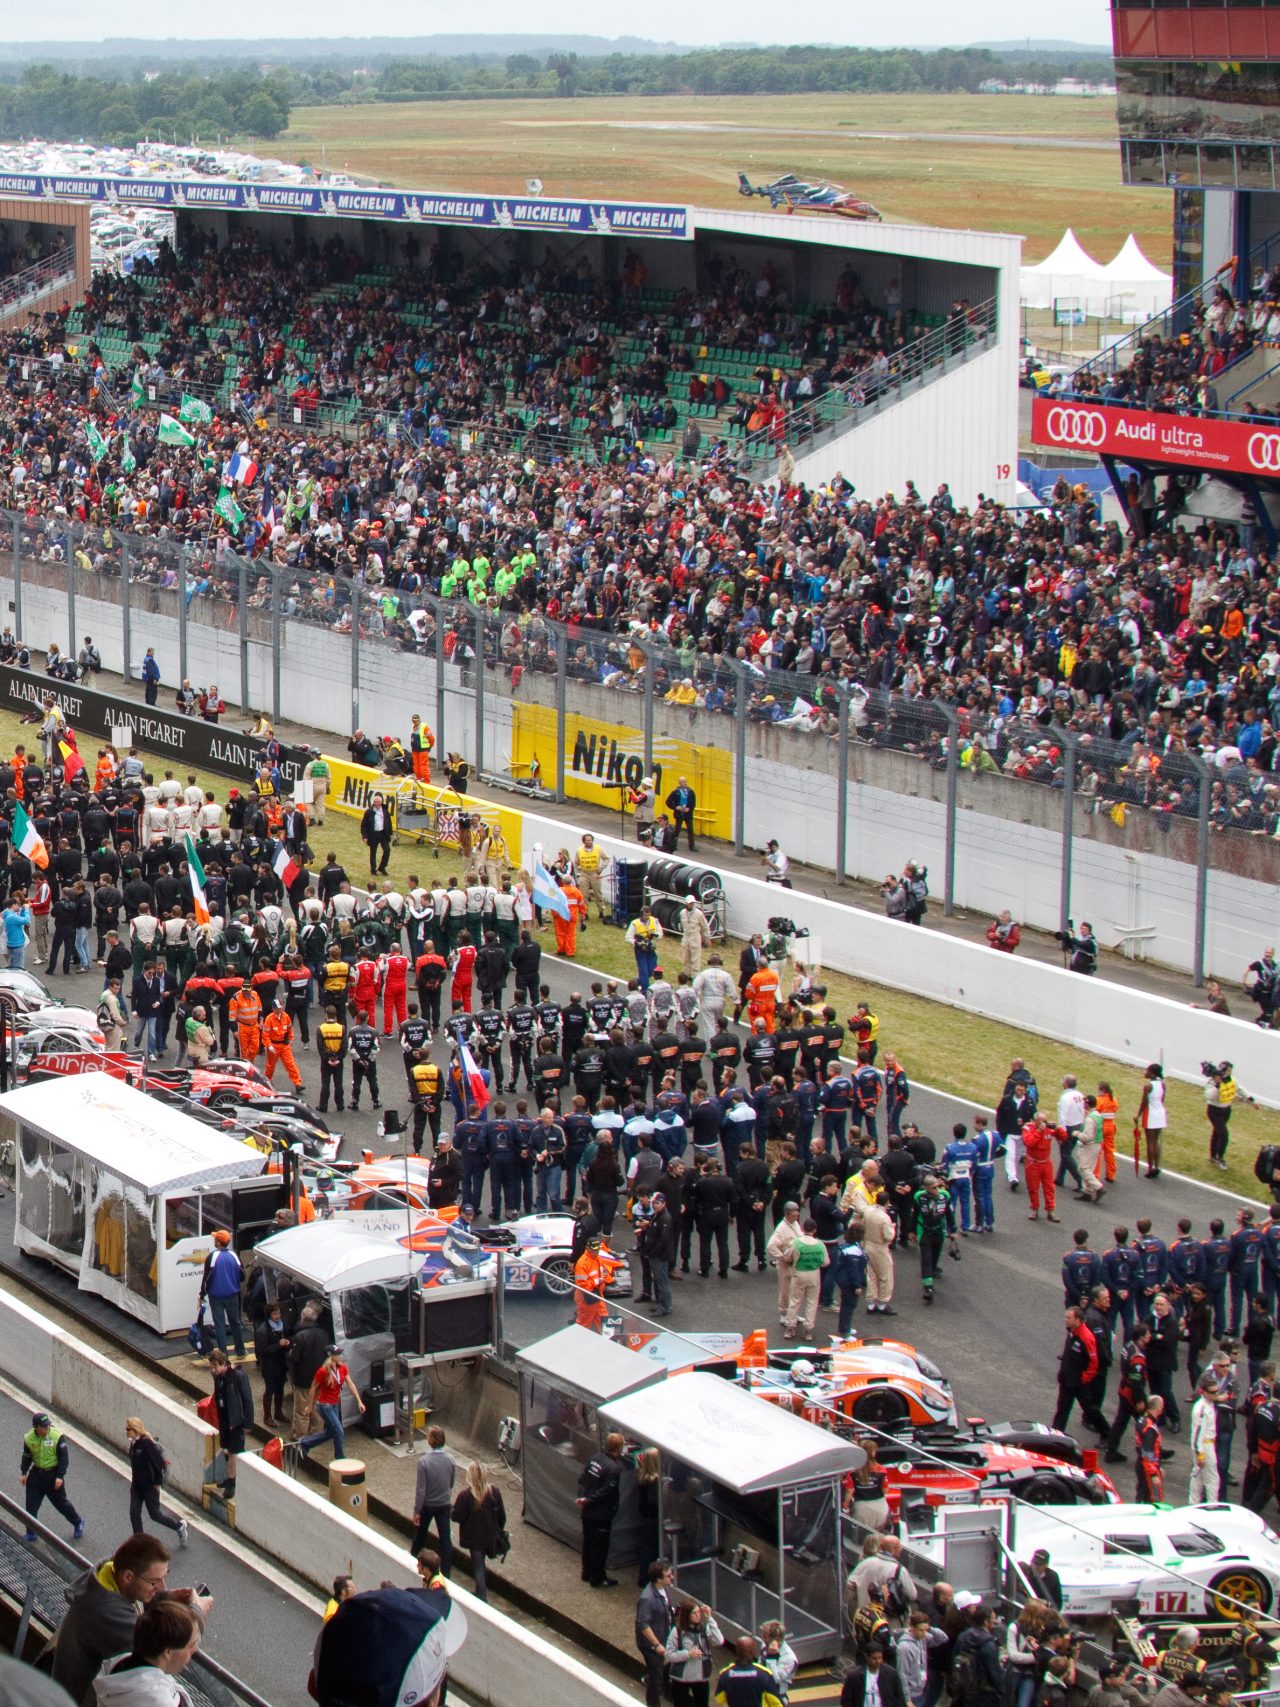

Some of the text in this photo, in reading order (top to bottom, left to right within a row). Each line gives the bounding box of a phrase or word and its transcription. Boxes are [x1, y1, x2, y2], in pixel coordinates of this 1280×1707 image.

[55, 180, 98, 194] MICHELIN
[119, 184, 165, 198] MICHELIN
[187, 186, 237, 201] MICHELIN
[259, 190, 313, 206] MICHELIN
[338, 195, 396, 212] MICHELIN
[422, 200, 484, 217] MICHELIN
[514, 204, 582, 223] MICHELIN
[612, 210, 685, 228] MICHELIN
[1115, 419, 1203, 447] Audi ultra
[1162, 446, 1230, 462] lightweight technology
[996, 464, 1010, 480] 19
[10, 680, 38, 702] ALAIN
[104, 708, 186, 748] ALAIN FIGARET
[209, 739, 301, 781] ALAIN FIRET
[572, 730, 662, 796] Nikon
[344, 775, 396, 816] Nikon
[442, 822, 455, 834] 44
[202, 1089, 211, 1098] P2
[180, 1270, 204, 1278] CHEVR
[510, 1267, 529, 1282] 25
[1140, 1601, 1150, 1611] P1
[1160, 1592, 1183, 1611] 17
[1197, 1637, 1232, 1646] LOTUS
[1164, 1657, 1194, 1670] LOTUS
